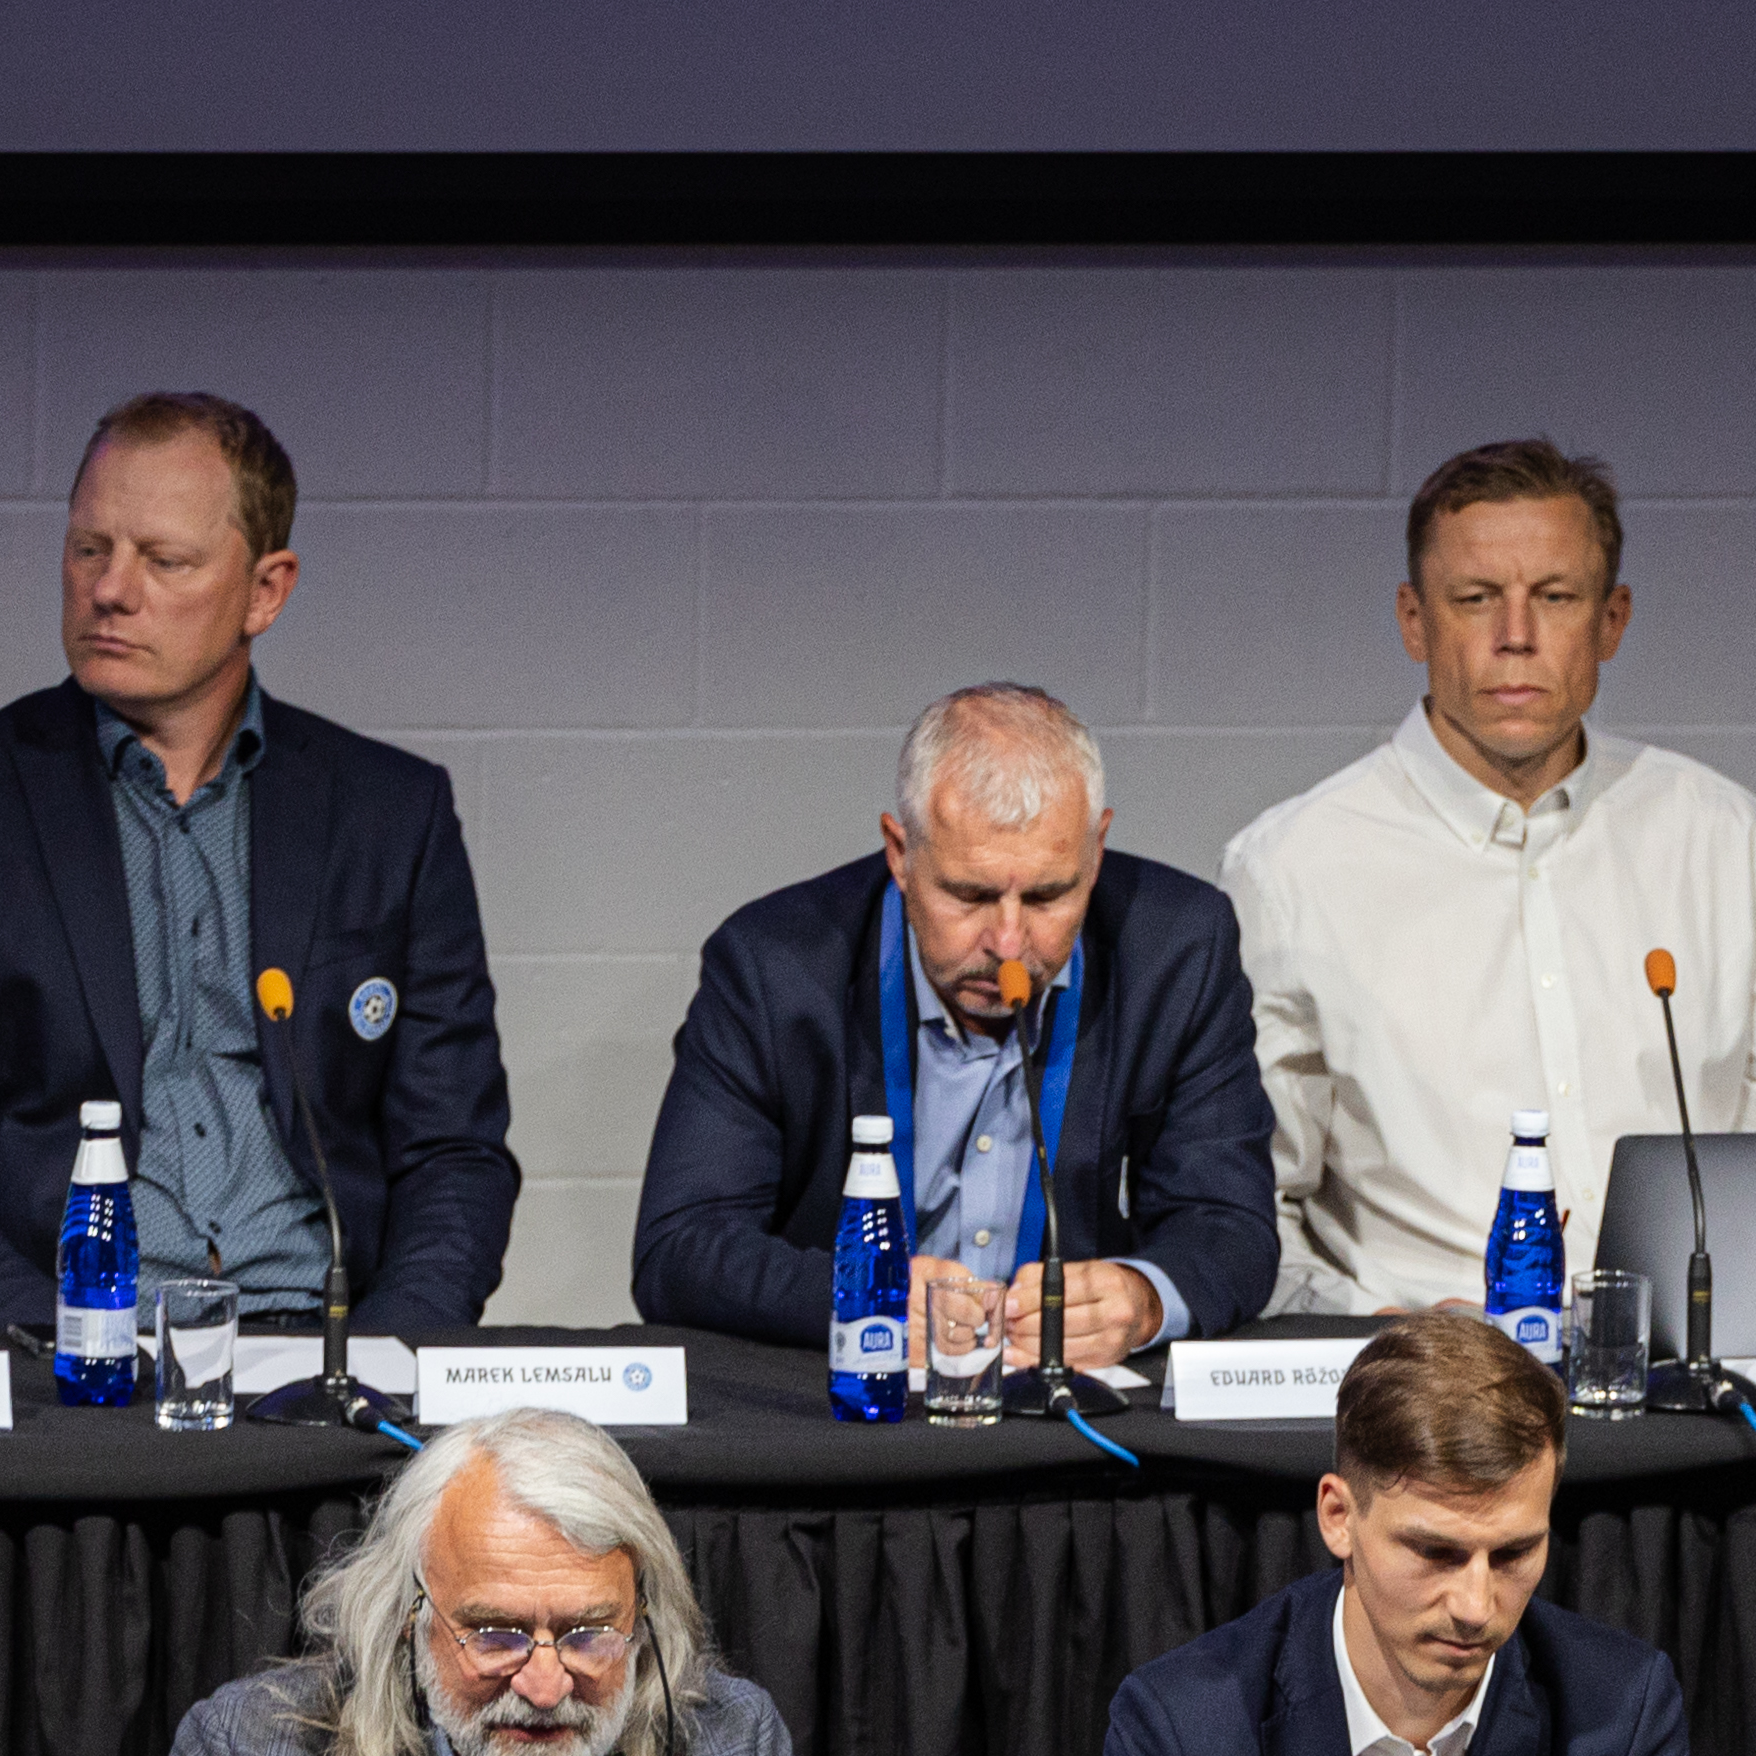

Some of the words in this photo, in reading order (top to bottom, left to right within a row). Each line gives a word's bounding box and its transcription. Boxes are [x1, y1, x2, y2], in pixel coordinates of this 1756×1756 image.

[1519, 1322, 1546, 1339] AURA
[863, 1332, 891, 1348] AURA
[446, 1367, 514, 1384] MAREK
[521, 1366, 612, 1384] LEMSALU
[1211, 1369, 1285, 1386] EDUARD
